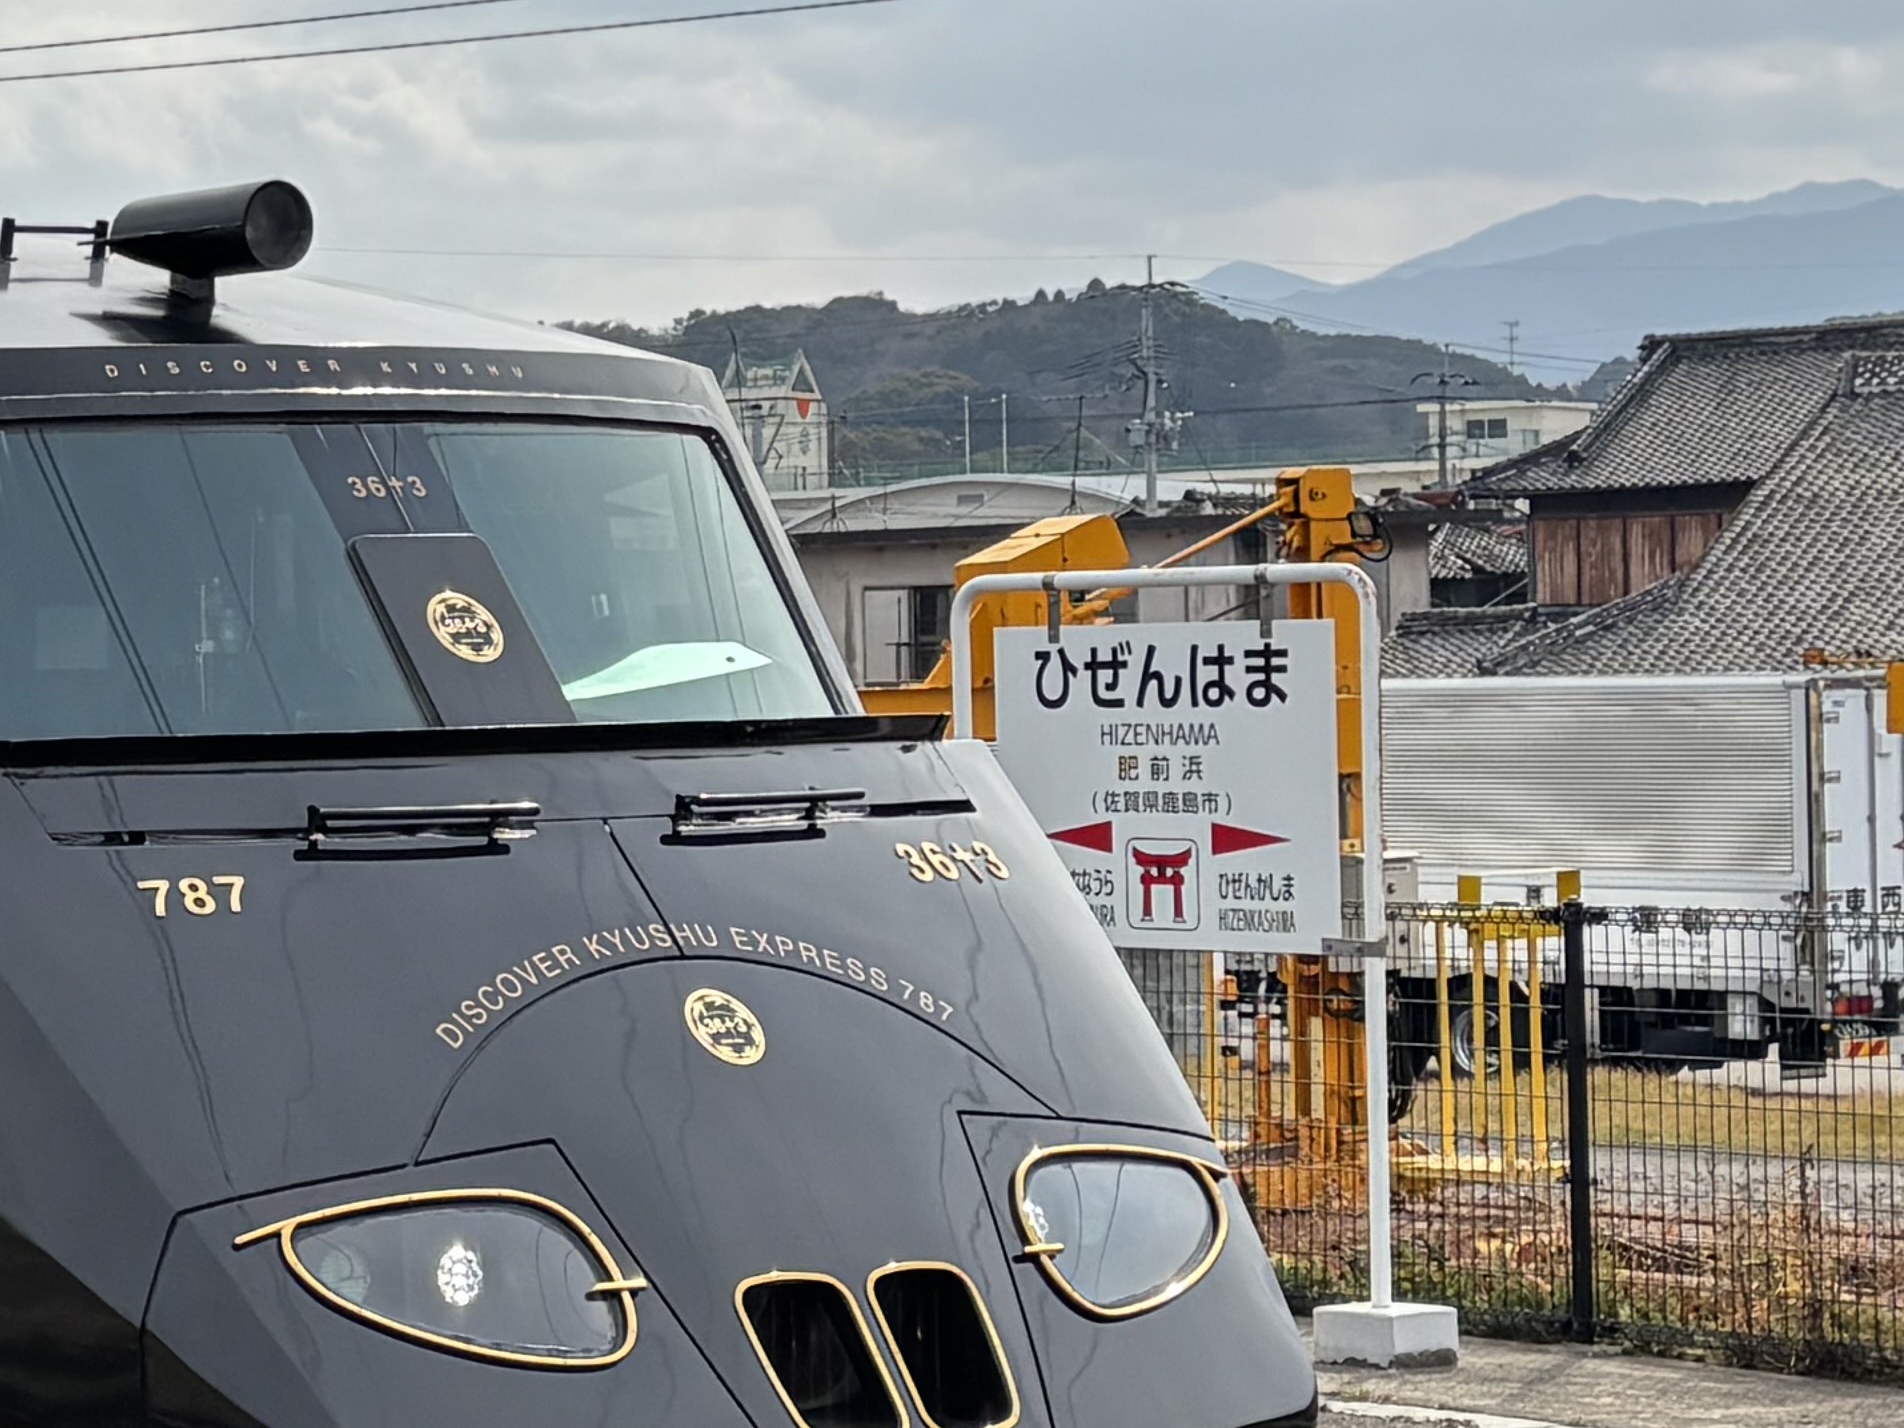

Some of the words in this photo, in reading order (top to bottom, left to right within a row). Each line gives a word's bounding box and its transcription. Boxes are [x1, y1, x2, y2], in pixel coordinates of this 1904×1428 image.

[105, 358, 341, 378] DISCOVER
[380, 360, 523, 379] KYUSHU
[1034, 640, 1289, 709] ひぜんはま
[1100, 722, 1220, 746] HIZENHAMA
[137, 874, 247, 919] 787
[435, 943, 581, 1050] DISCOVER
[582, 922, 719, 960] KYUSHU
[729, 926, 889, 992] EXPRESS
[898, 978, 954, 1022] 787
